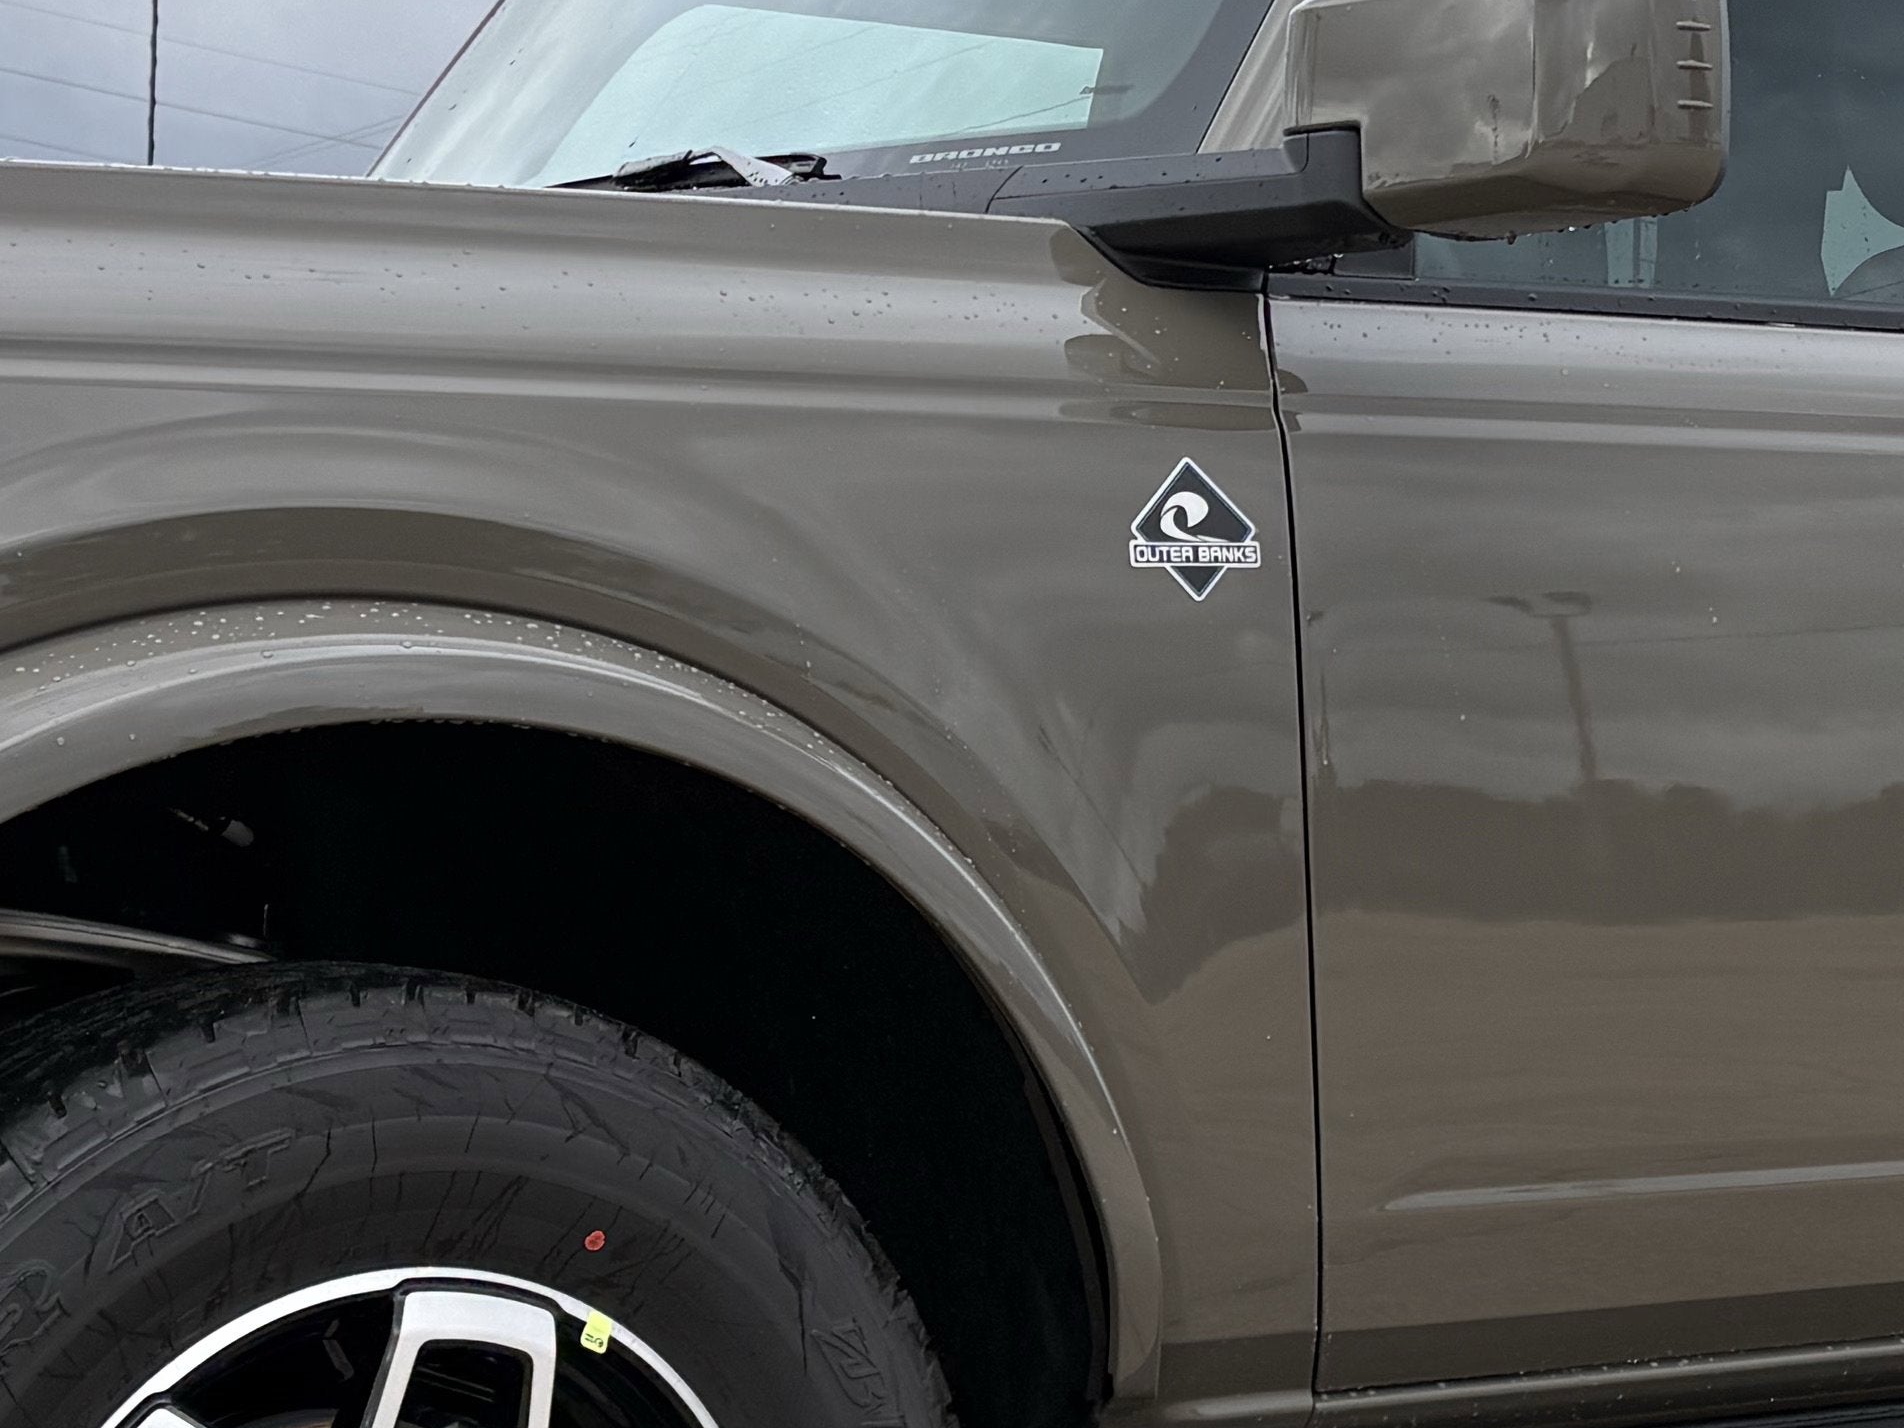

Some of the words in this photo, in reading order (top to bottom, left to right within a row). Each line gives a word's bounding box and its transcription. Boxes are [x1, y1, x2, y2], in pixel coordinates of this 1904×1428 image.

[908, 141, 1062, 165] BRONCO
[1135, 545, 1194, 563] OUTER
[1197, 545, 1257, 563] BANKS
